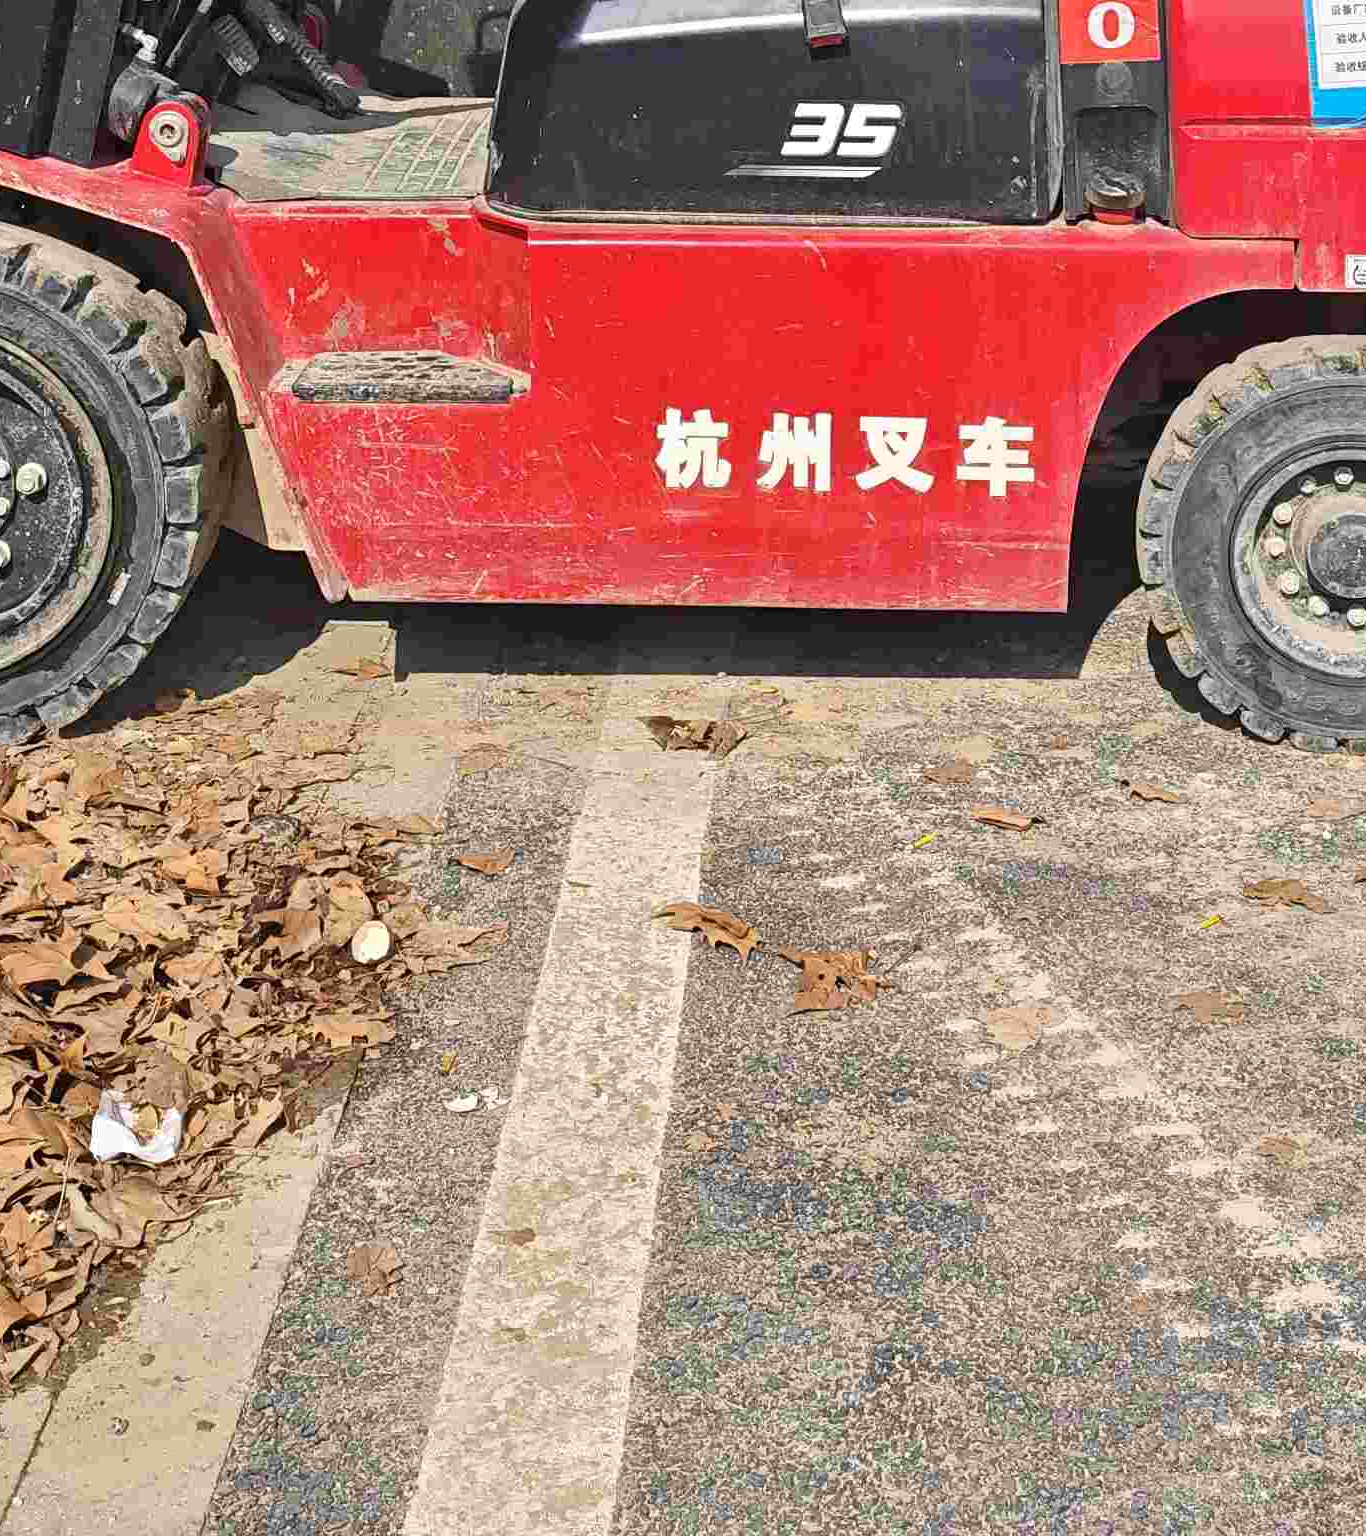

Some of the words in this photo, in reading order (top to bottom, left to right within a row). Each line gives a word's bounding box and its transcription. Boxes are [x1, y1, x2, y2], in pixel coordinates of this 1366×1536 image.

[780, 102, 902, 157] 35
[656, 408, 1035, 497] 杭州叉车
